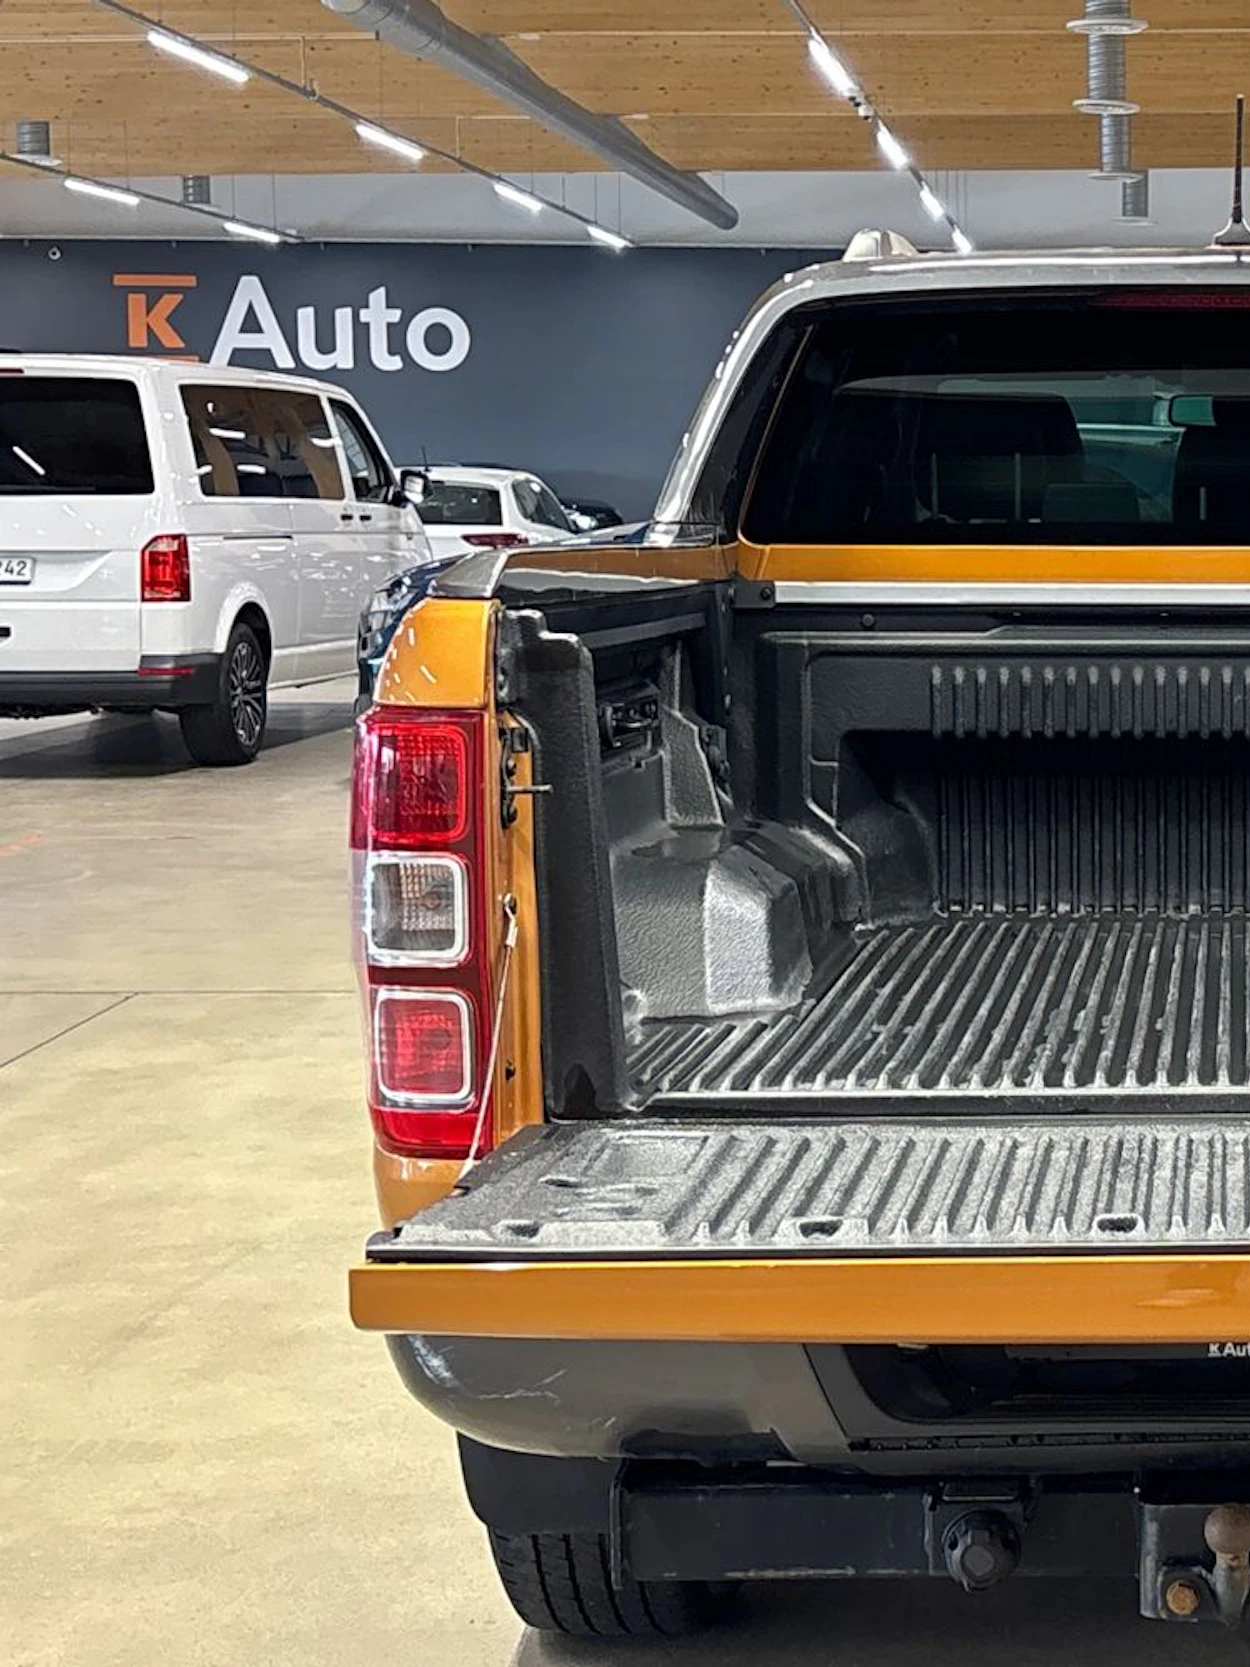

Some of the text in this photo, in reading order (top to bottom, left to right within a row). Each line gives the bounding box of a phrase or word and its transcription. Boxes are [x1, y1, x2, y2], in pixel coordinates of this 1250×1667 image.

[127, 275, 471, 371] K Auto
[1208, 1343, 1220, 1356] K
